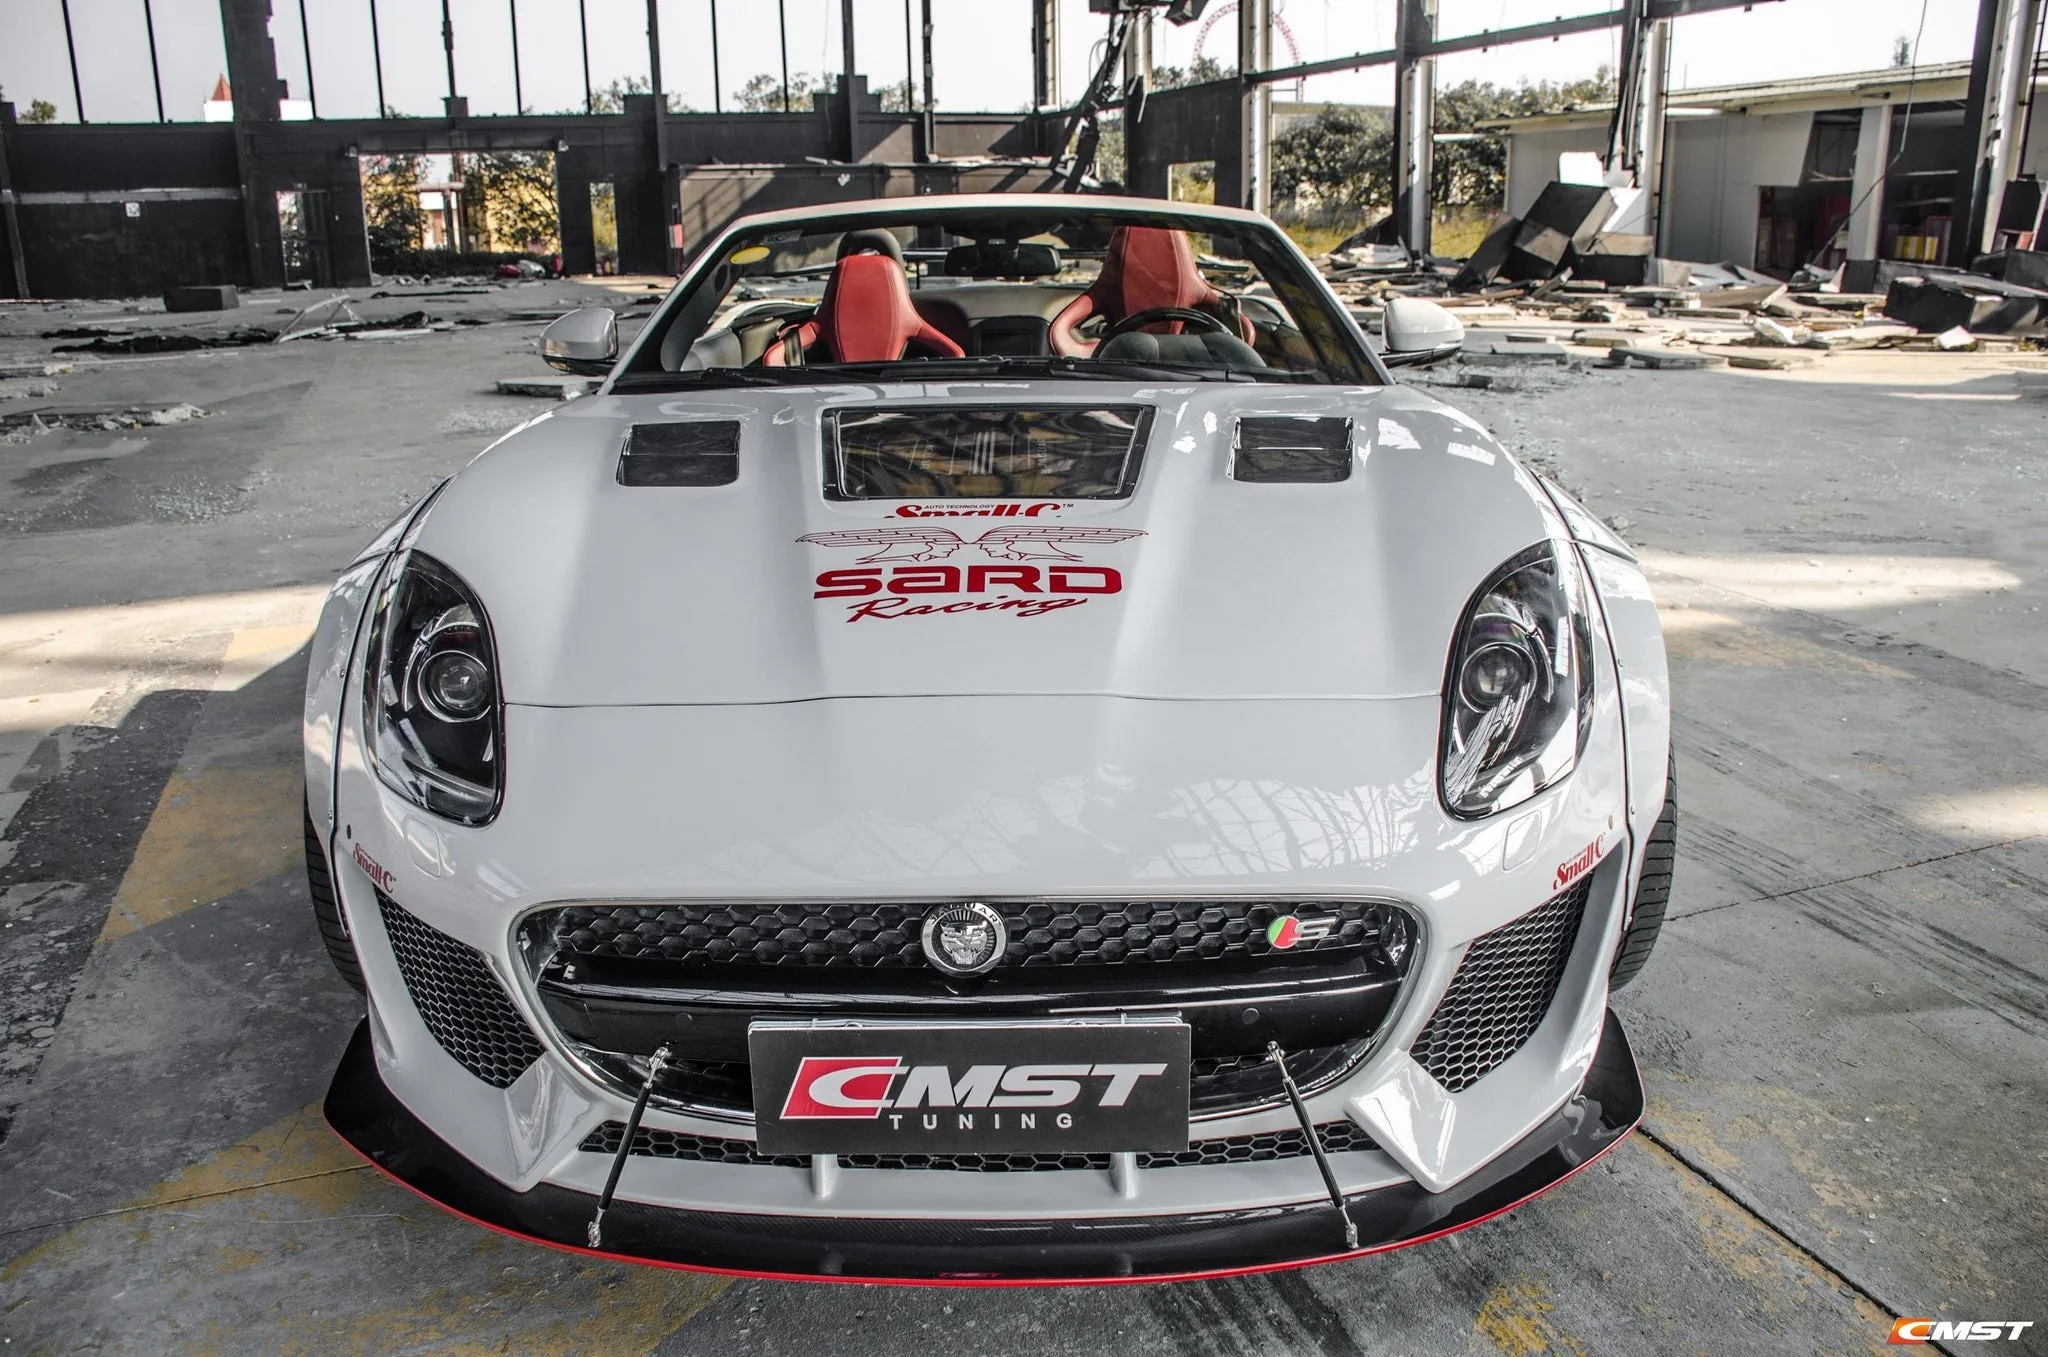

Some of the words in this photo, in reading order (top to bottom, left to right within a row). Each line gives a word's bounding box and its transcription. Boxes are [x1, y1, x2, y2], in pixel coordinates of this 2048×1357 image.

[846, 595, 1089, 623] Racing
[929, 902, 999, 925] JAGUAR
[808, 1063, 1168, 1108] CMST
[888, 1113, 1073, 1130] TUNING
